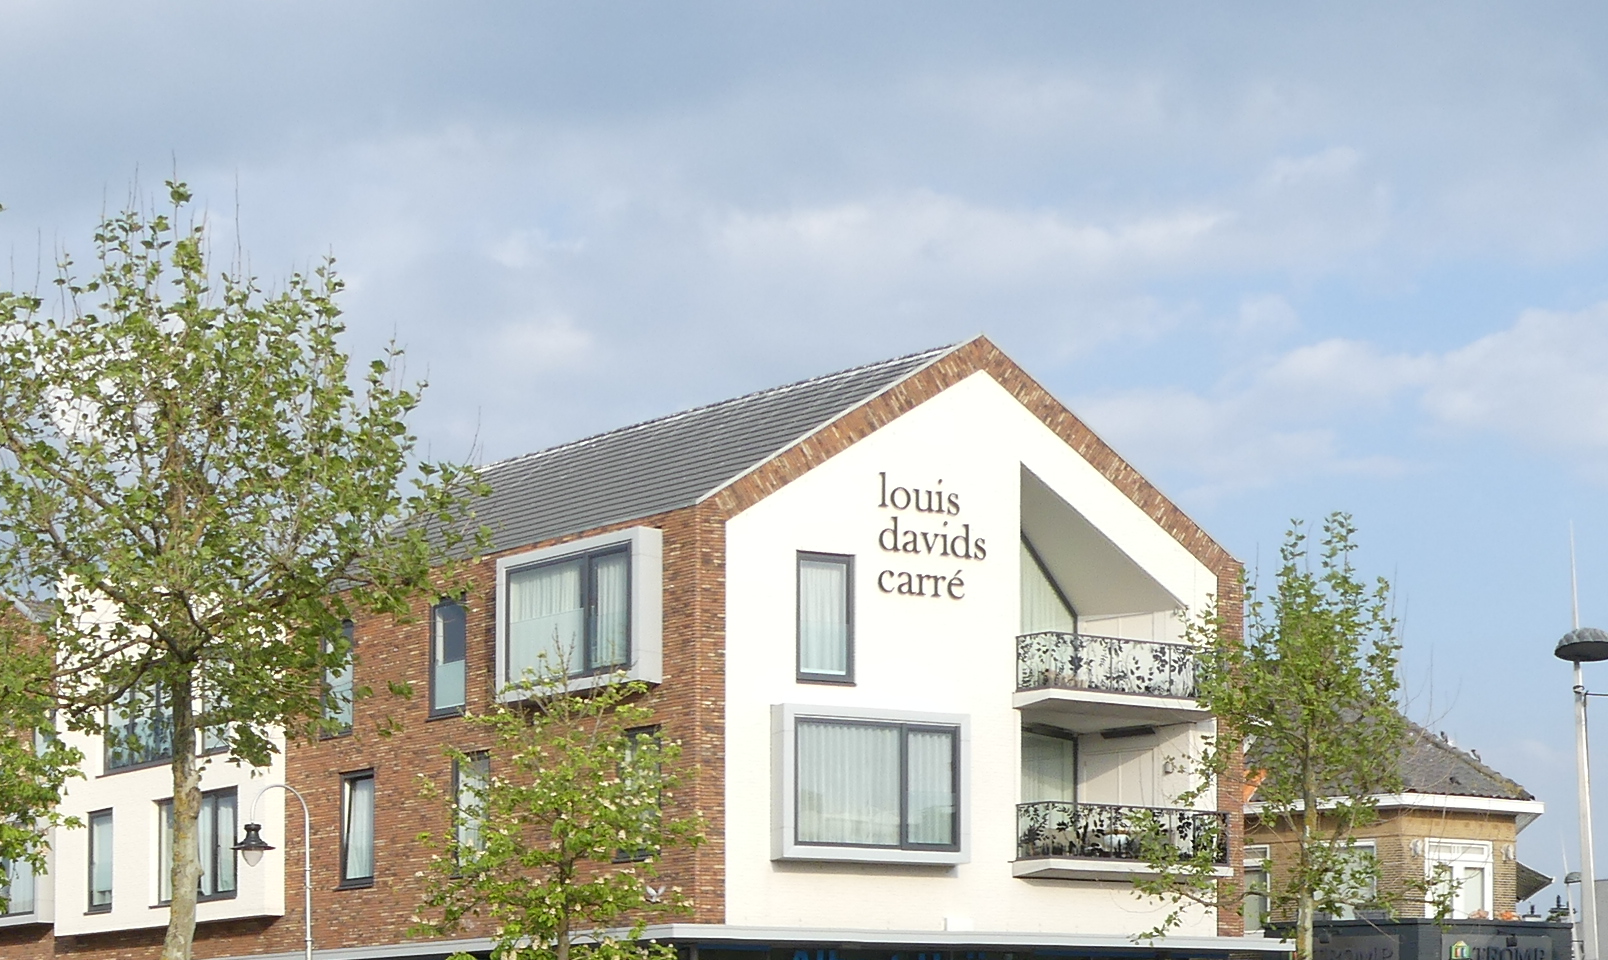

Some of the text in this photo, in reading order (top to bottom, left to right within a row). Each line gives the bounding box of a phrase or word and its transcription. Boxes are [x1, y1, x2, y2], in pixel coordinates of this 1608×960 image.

[878, 472, 960, 516] louis
[878, 516, 987, 561] davids
[878, 569, 965, 600] carré
